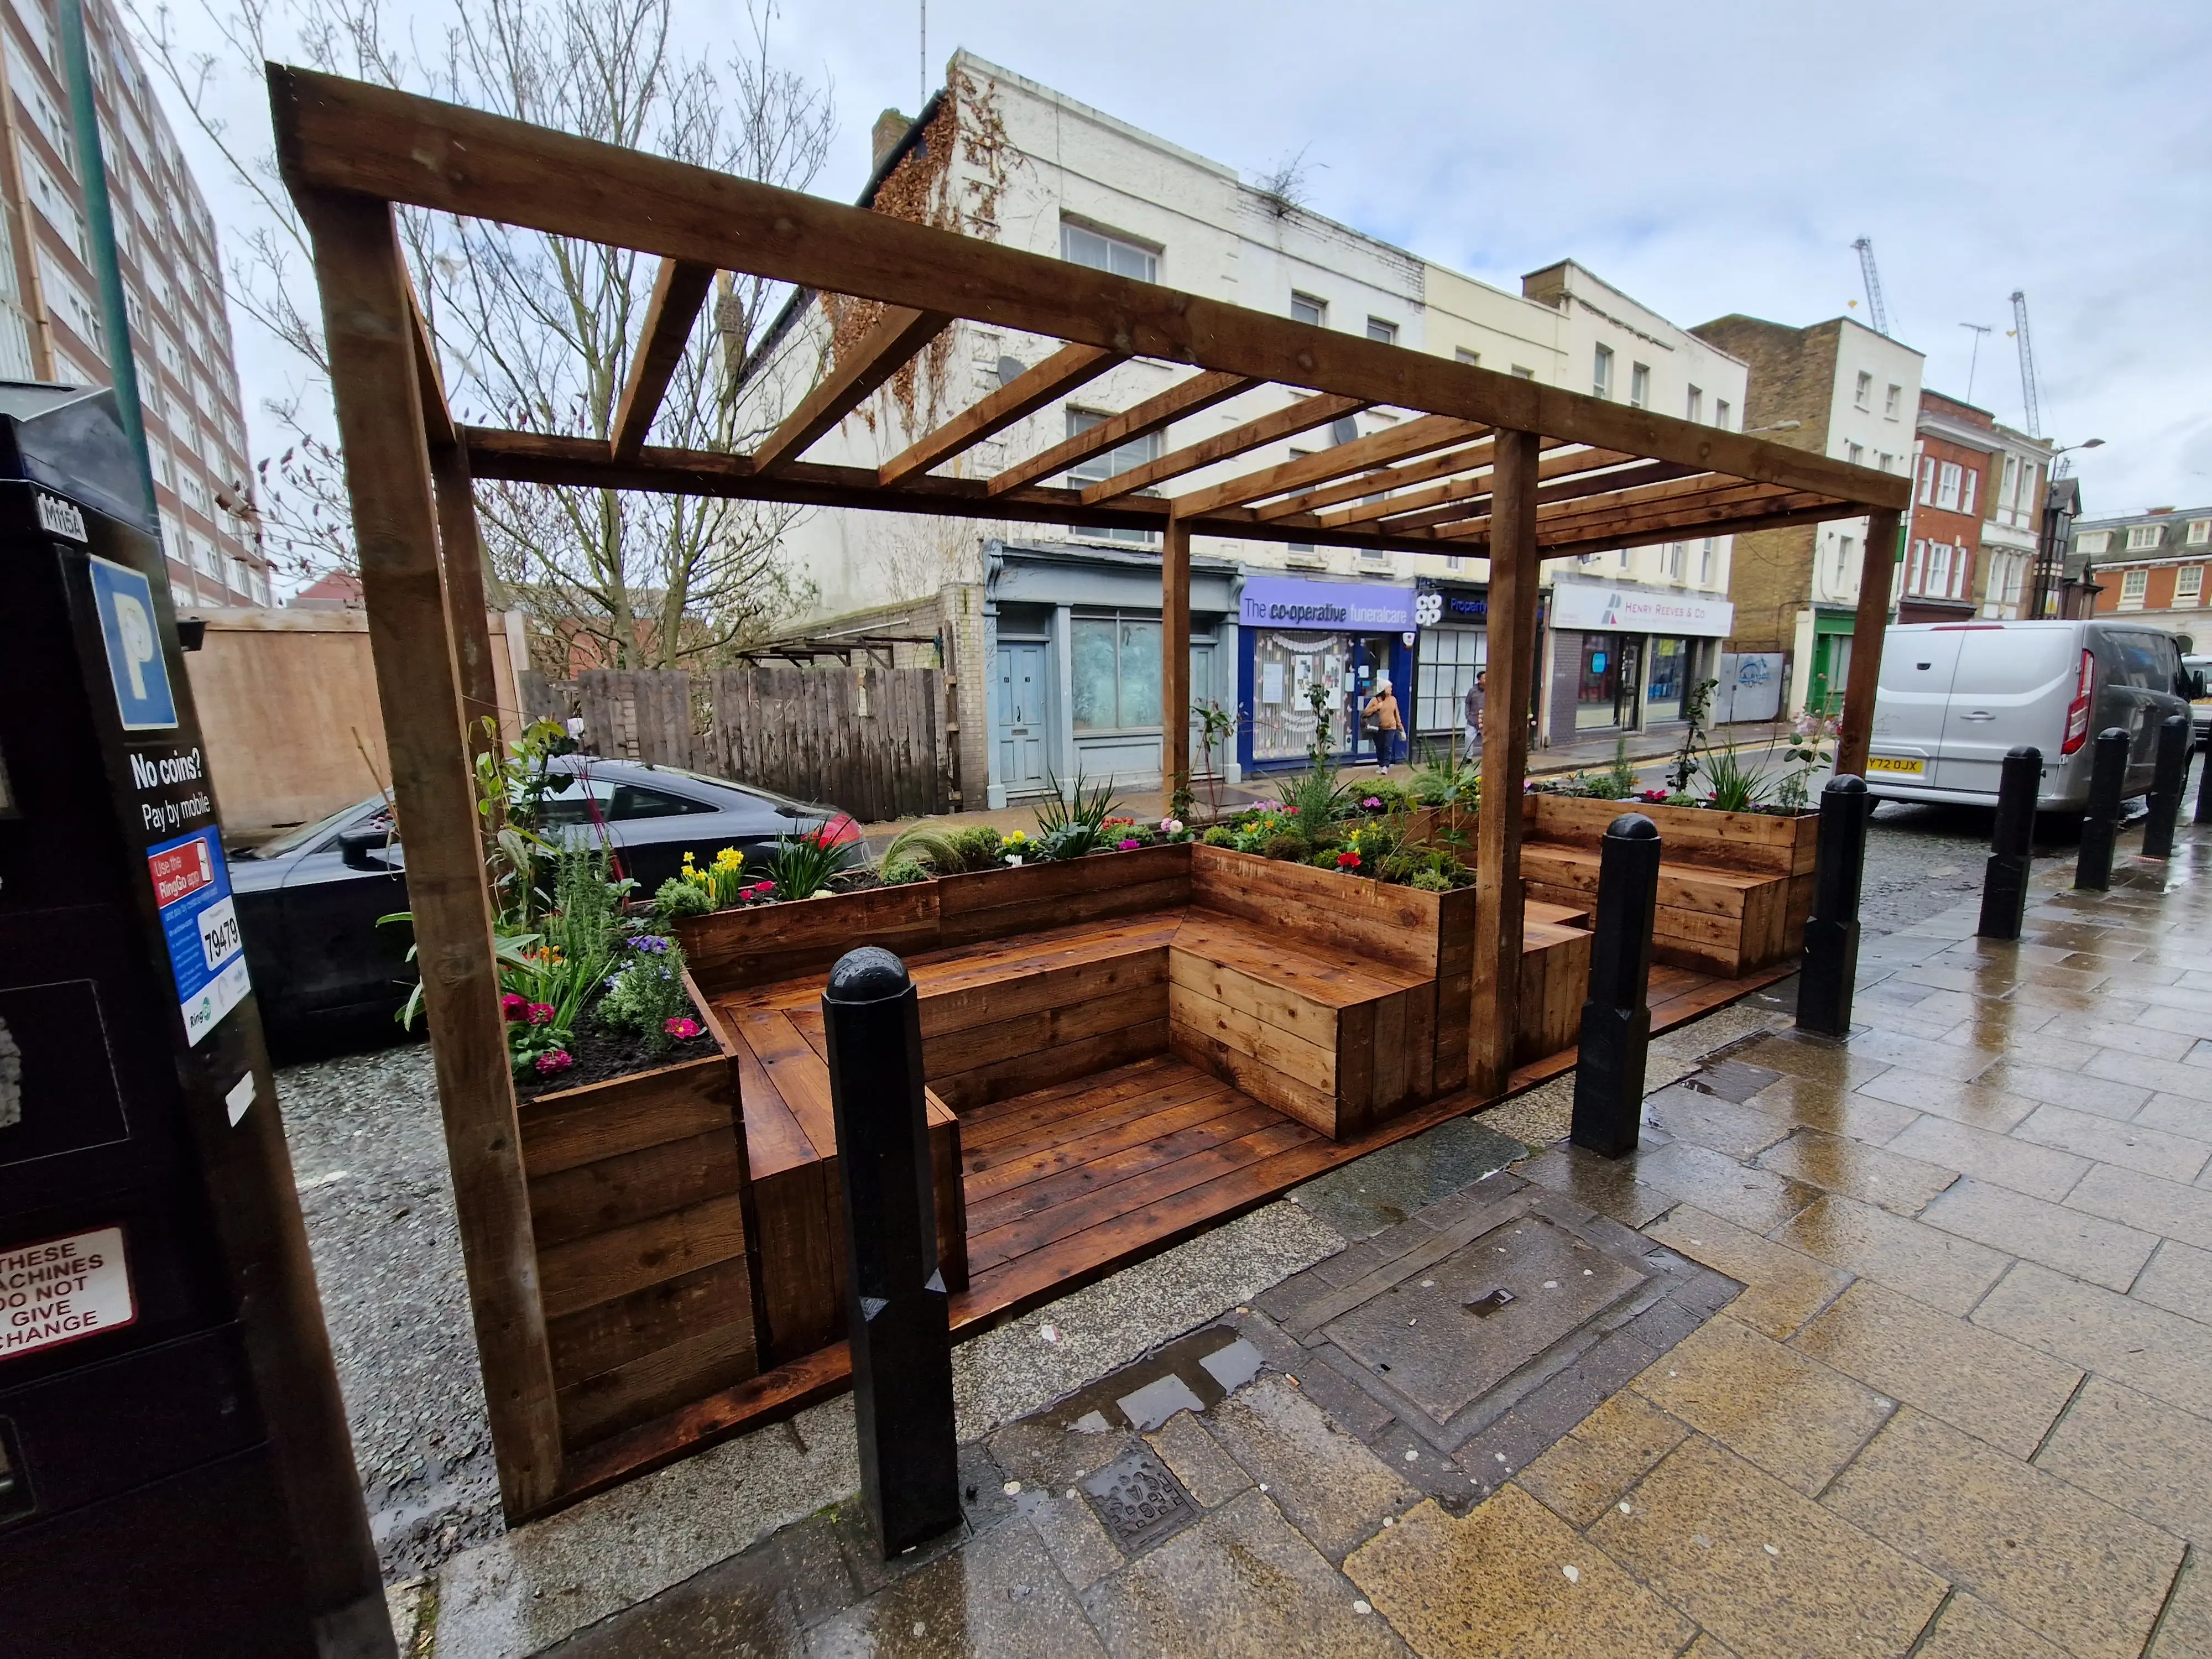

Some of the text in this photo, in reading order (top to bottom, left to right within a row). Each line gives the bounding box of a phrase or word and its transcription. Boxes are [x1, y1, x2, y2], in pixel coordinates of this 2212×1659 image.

[1245, 598, 1407, 624] The co-operative funeralcare
[1687, 607, 1692, 617] &
[113, 592, 153, 699] P
[130, 747, 202, 789] No coins?
[1869, 758, 1891, 769] Y72
[142, 791, 211, 832] Pay by mobile
[155, 855, 182, 877] Use the
[158, 874, 187, 899] RingGo
[187, 870, 200, 888] app
[204, 917, 238, 962] 79479
[0, 1254, 104, 1291] ACHINES
[36, 1276, 87, 1301] NOT
[12, 1300, 71, 1326] GIVE
[0, 1310, 98, 1349] HANGE
